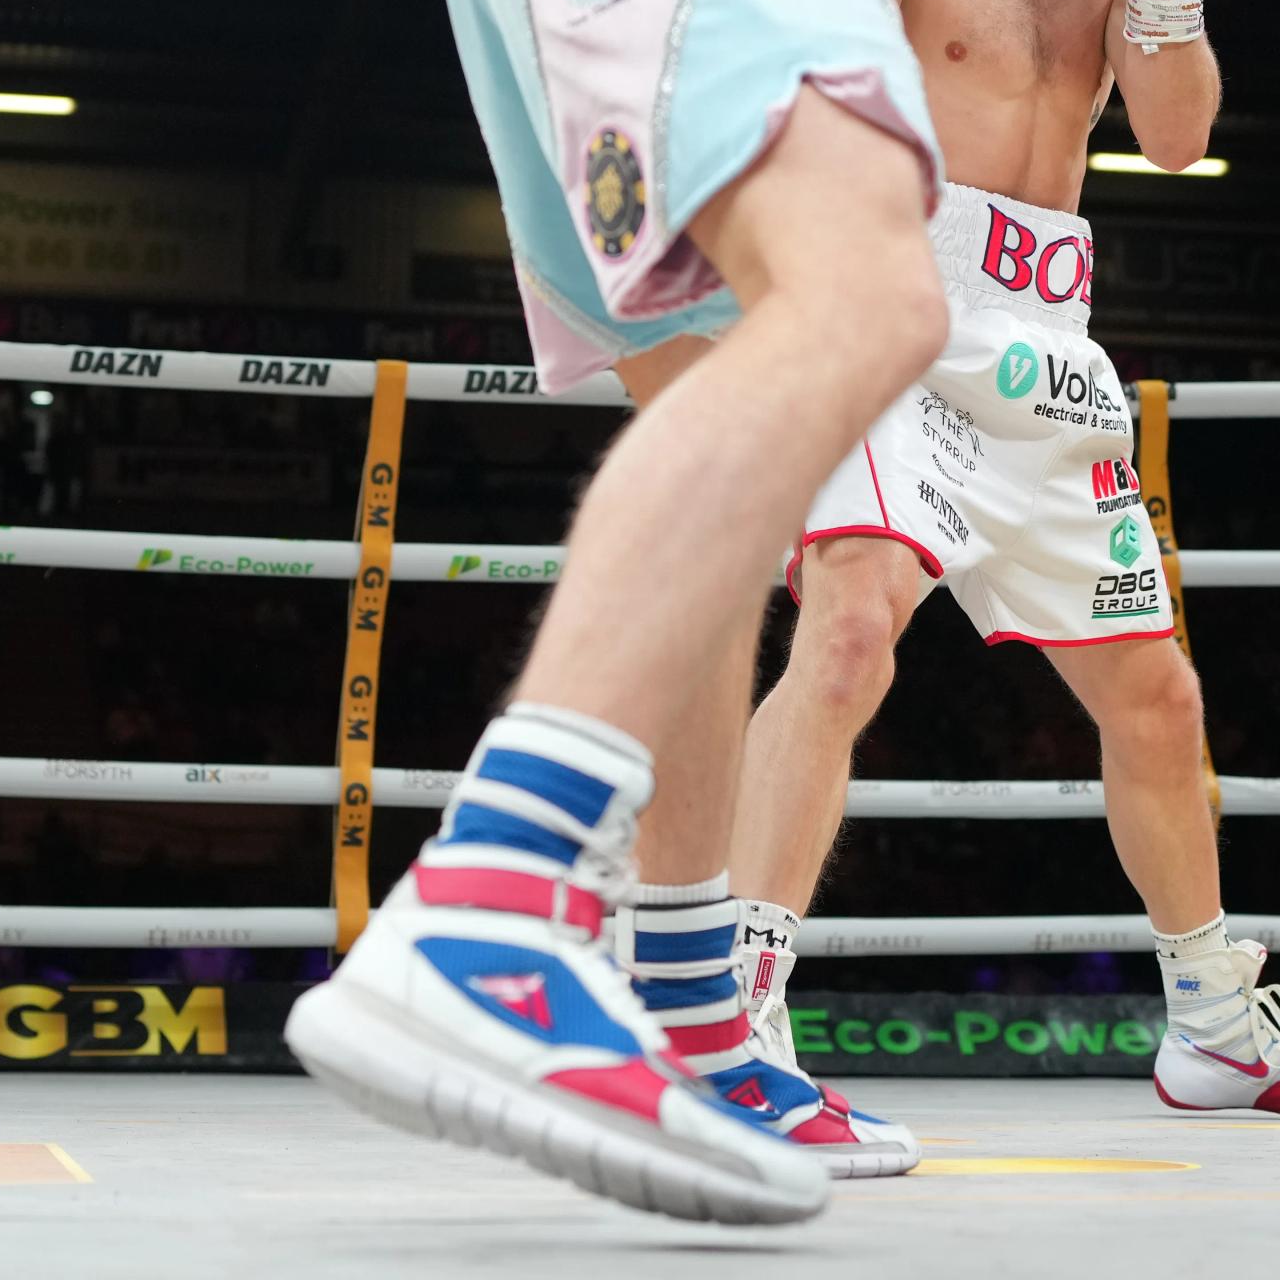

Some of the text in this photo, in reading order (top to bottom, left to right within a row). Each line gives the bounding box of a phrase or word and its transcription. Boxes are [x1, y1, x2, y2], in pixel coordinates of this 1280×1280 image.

[69, 349, 163, 378] DAZN
[239, 359, 330, 388] DAZN
[940, 411, 964, 442] THE
[1034, 402, 1127, 434] electrical & security
[922, 422, 976, 473] STYRRUP
[917, 479, 969, 547] HUNTERS
[179, 554, 315, 576] Eco-Power
[1095, 569, 1156, 596] DBG
[1092, 594, 1158, 611] GROUP
[185, 763, 221, 784] aix
[177, 927, 253, 943] HARLEY
[852, 934, 925, 951] HARLEY
[1060, 932, 1131, 950] HARLEY
[1176, 979, 1201, 991] NIKE
